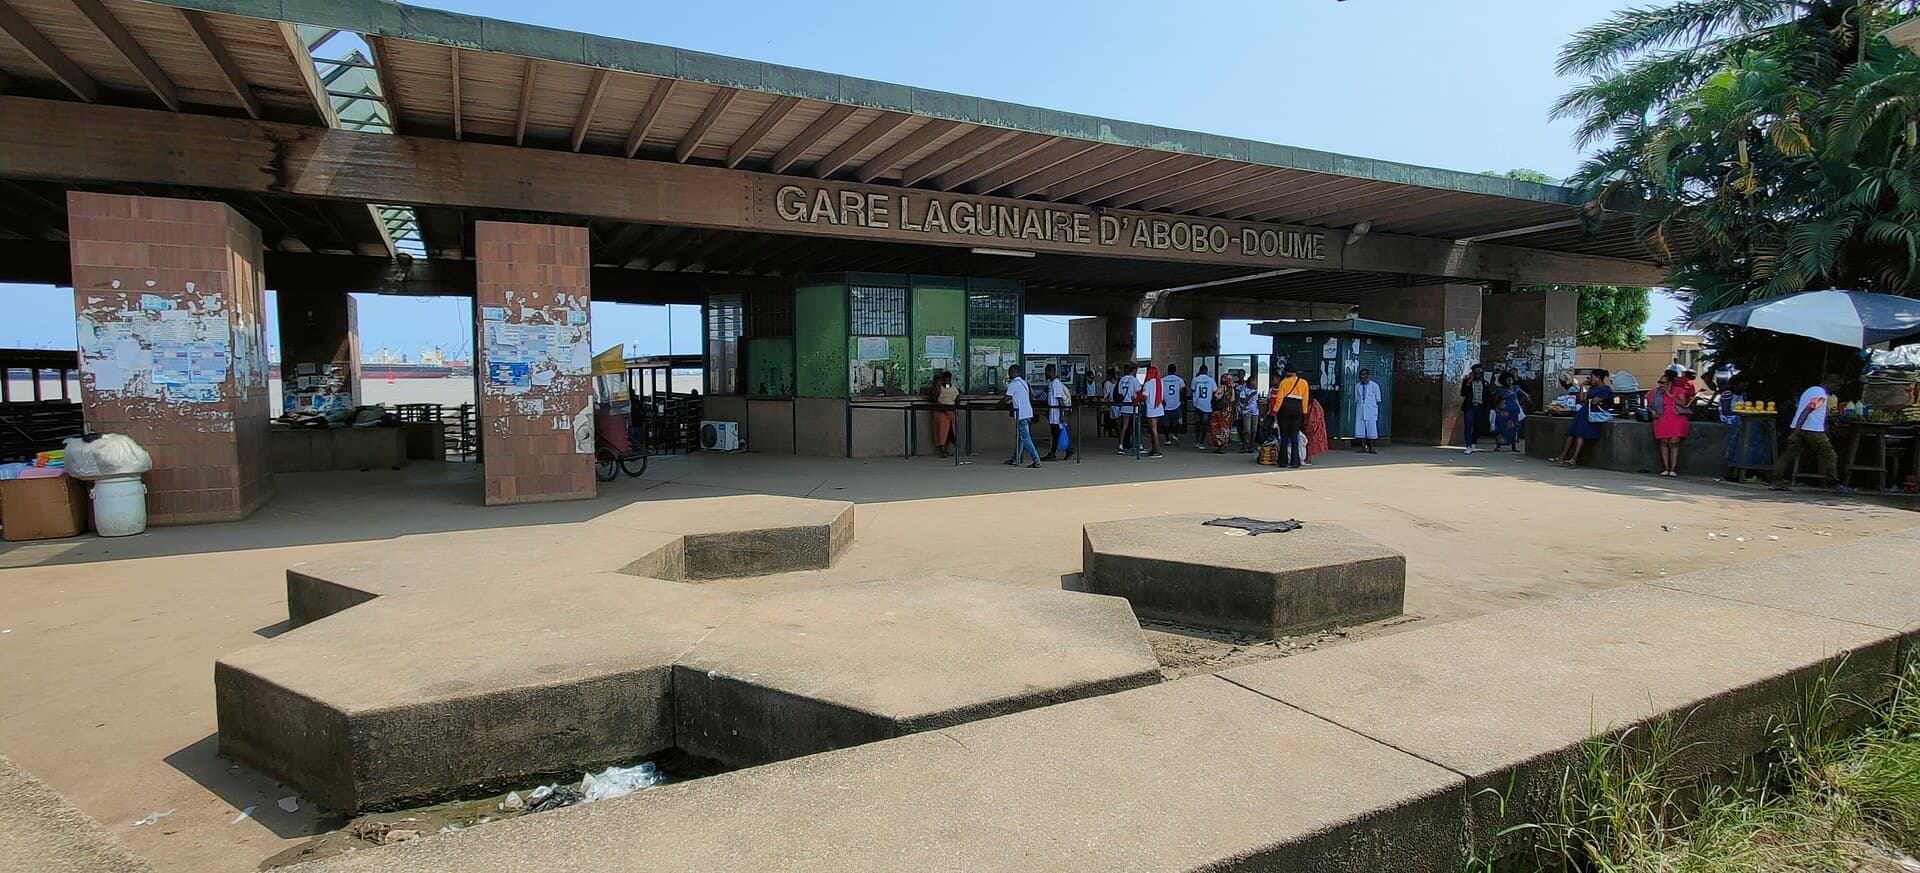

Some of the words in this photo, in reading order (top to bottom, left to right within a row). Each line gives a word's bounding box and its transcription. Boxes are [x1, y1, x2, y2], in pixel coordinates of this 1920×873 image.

[776, 185, 889, 228] GARE
[901, 196, 1091, 243] LAGUNAIRE
[1168, 384, 1176, 396] 5
